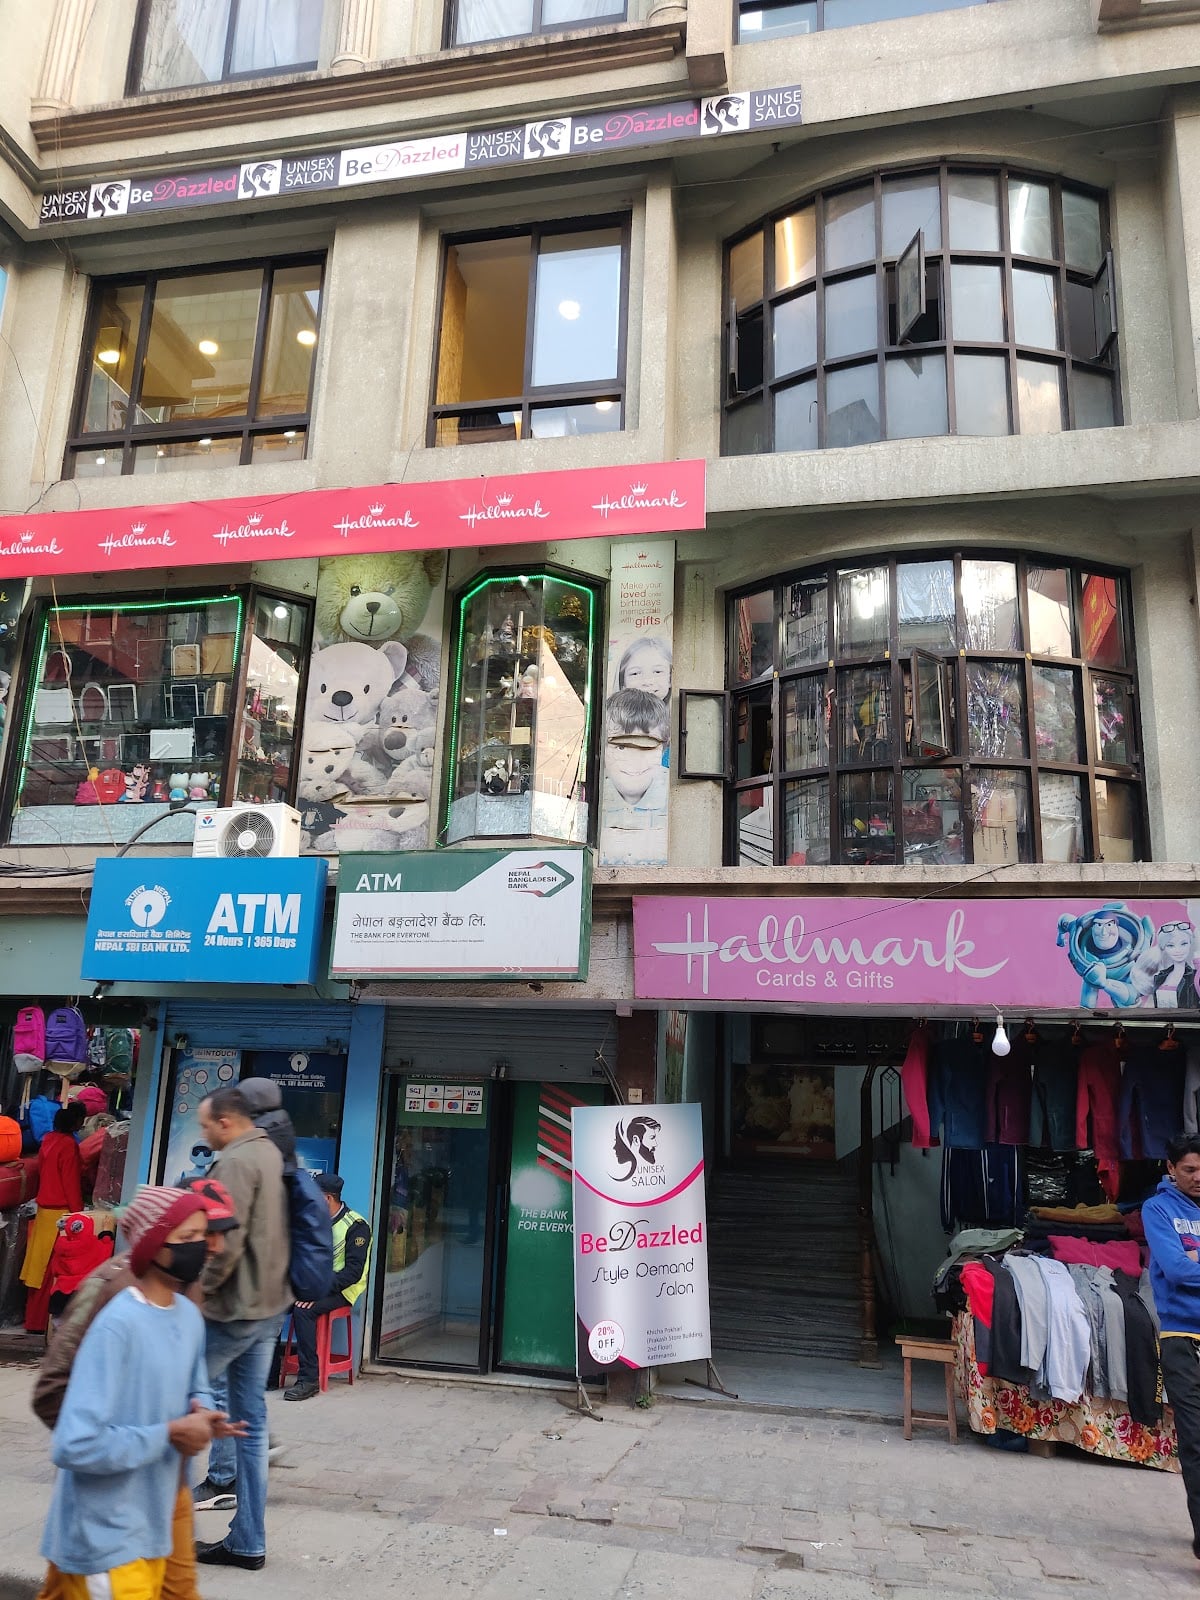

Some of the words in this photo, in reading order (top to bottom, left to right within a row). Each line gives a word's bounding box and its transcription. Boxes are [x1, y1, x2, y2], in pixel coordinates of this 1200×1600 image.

[470, 130, 521, 149] UNISEX
[468, 142, 521, 161] SALON
[287, 157, 335, 174] UNISEX
[285, 169, 334, 186] SALON
[43, 190, 88, 207] UNISEX
[41, 202, 86, 219] SALON
[591, 490, 687, 518] Hallmark
[333, 510, 419, 537] Hallmark
[459, 502, 550, 528] Hallmark
[212, 520, 296, 547] Hallmark
[98, 529, 177, 556] Hallmark
[621, 560, 663, 572] Hallmark
[620, 590, 646, 599] loved
[621, 582, 644, 590] Make
[646, 582, 662, 590] your
[620, 599, 661, 608] birthdays
[635, 615, 661, 629] gifts
[355, 873, 402, 891] ATM
[153, 885, 172, 906] NEPAL
[206, 893, 301, 934] ATM
[352, 913, 384, 928] नेपाल
[441, 912, 464, 927] बैंक
[468, 913, 486, 928] लि.
[94, 941, 124, 952] NEPAL
[125, 942, 140, 952] SBI
[170, 943, 190, 953] LTD.
[204, 935, 216, 947] 24
[217, 935, 244, 947] Hours
[254, 936, 272, 948] 365
[273, 936, 296, 949] Days
[651, 903, 1010, 994] Hallmark
[756, 969, 816, 988] Cards
[825, 971, 839, 989] &
[845, 970, 895, 990] Gifts
[637, 1164, 665, 1174] UNISEX
[631, 1175, 666, 1187] SALON
[520, 1208, 539, 1218] THE
[540, 1209, 568, 1220] BANK
[518, 1221, 538, 1231] FOR
[592, 1265, 629, 1284] Style
[656, 1281, 694, 1298] Salon
[597, 1326, 615, 1336] 20%
[598, 1337, 615, 1349] OFF
[647, 1352, 677, 1360] Kathmandu
